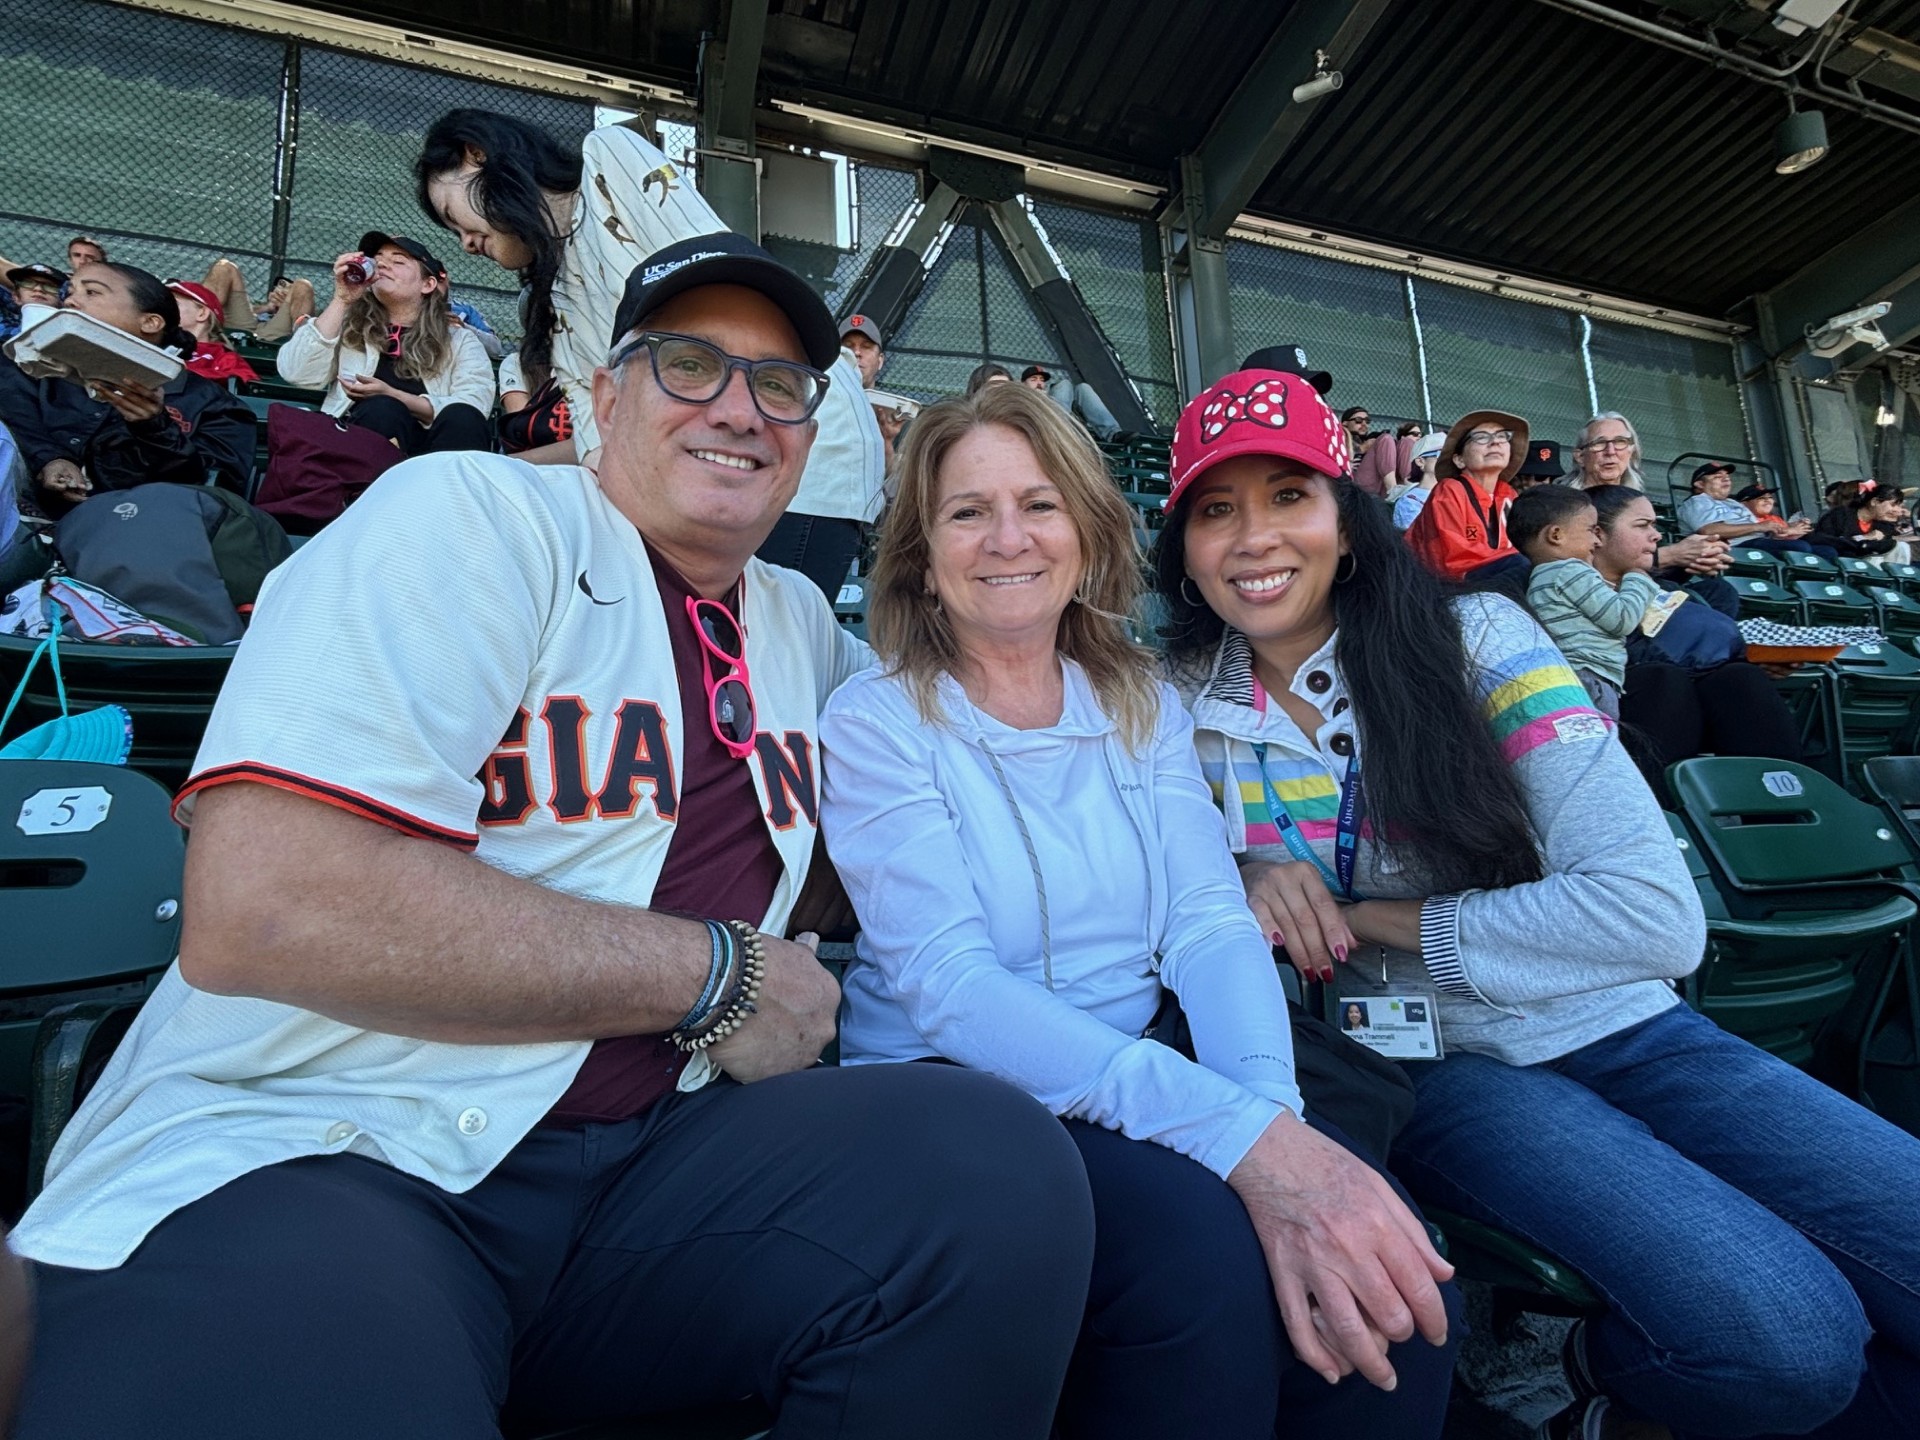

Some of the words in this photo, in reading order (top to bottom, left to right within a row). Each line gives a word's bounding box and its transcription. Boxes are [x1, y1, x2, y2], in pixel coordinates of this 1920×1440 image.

[644, 264, 665, 277] UC
[665, 259, 691, 272] San
[1769, 774, 1796, 793] 10
[50, 794, 81, 827] 5
[1342, 781, 1358, 827] Diversity
